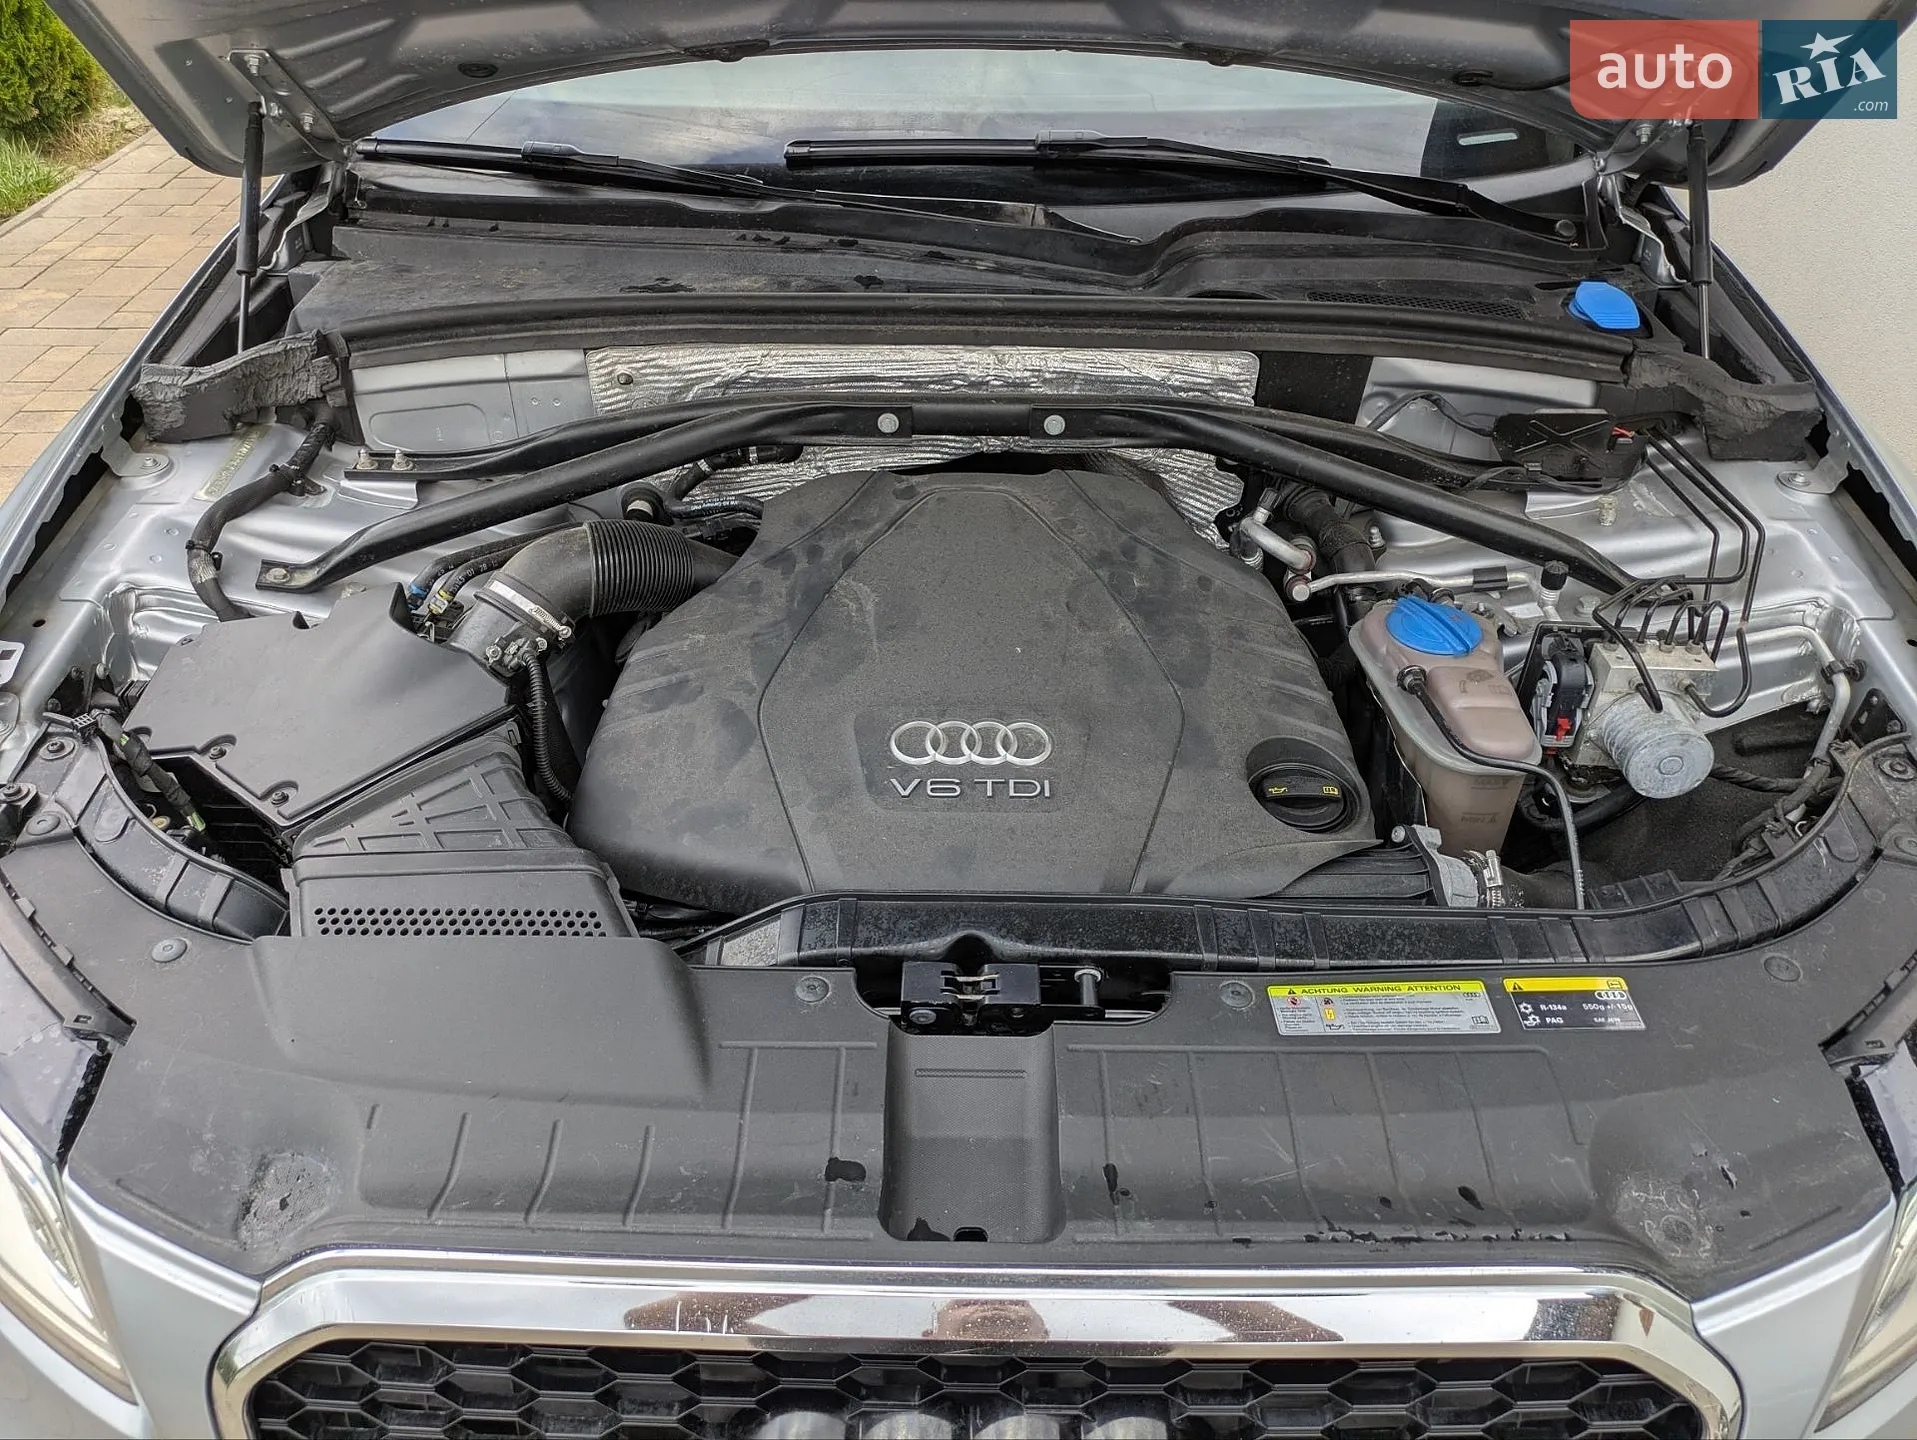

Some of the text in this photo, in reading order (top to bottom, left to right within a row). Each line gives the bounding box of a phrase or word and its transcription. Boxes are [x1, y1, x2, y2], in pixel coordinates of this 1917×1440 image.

[889, 778, 1050, 797] V6 TDI
[1301, 983, 1461, 995] ACHTUNG WARNING ATTENTION
